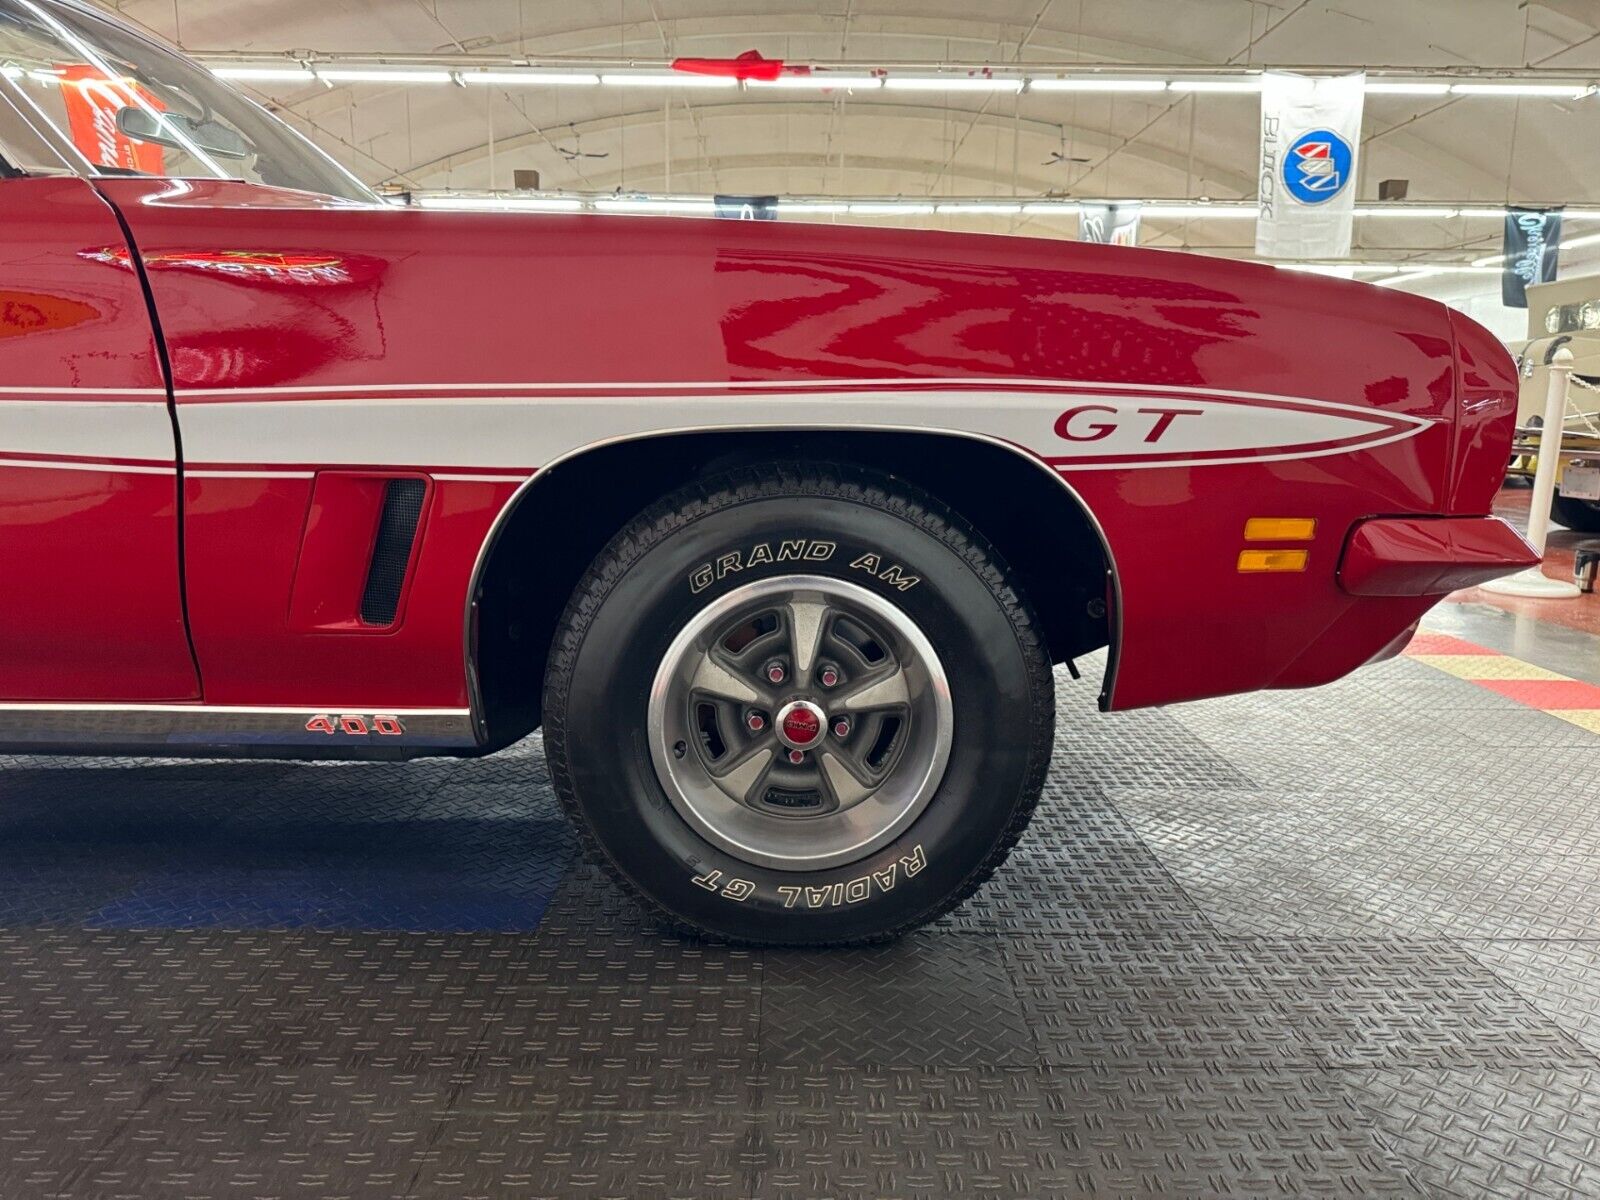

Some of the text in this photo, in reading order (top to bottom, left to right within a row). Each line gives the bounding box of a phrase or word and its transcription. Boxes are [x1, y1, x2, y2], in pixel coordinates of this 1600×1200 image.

[1260, 112, 1280, 221] BUICK
[1053, 405, 1204, 442] GT
[688, 539, 920, 594] GRAND AM
[305, 714, 404, 735] 400
[692, 845, 927, 908] RADIAL GT
